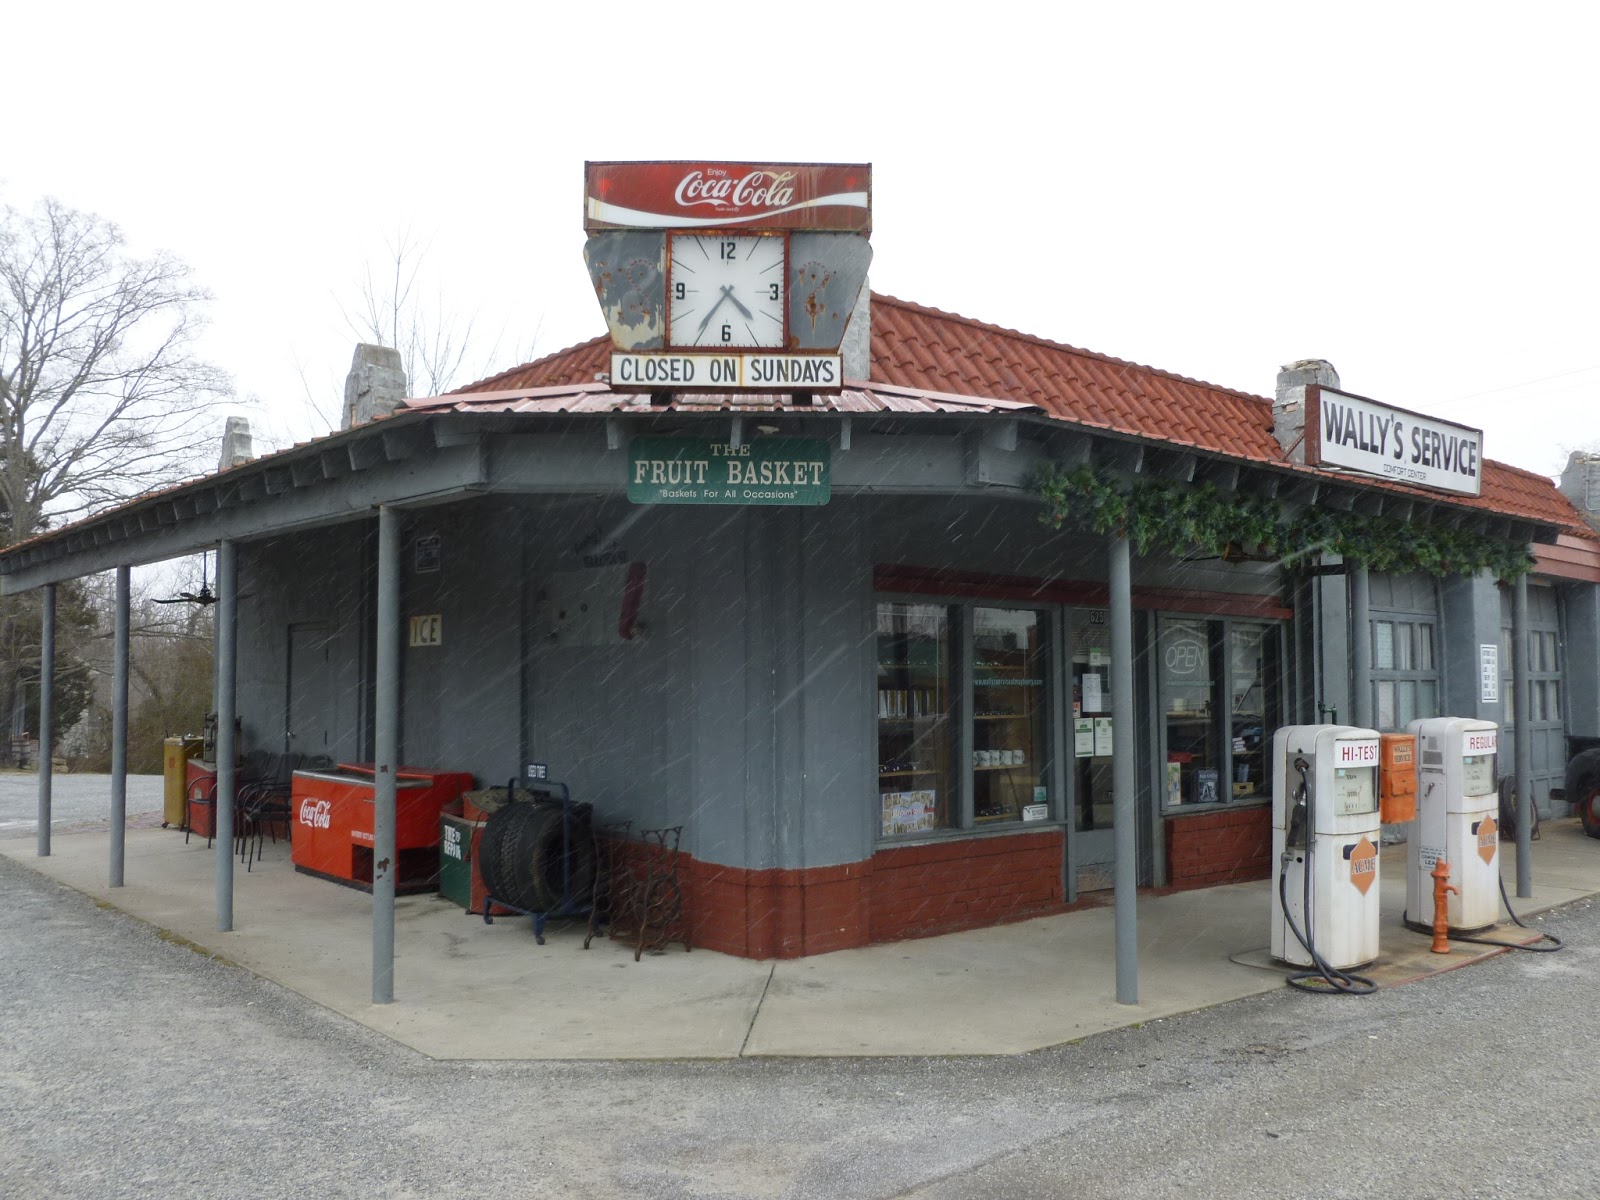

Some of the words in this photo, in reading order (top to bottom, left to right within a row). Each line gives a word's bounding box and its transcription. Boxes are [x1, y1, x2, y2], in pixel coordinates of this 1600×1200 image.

[707, 168, 727, 176] Enjoy
[674, 171, 798, 207] Coca-Cola
[720, 242, 736, 260] 12
[676, 282, 685, 300] 9
[769, 283, 779, 301] 3
[721, 325, 731, 342] 6
[620, 358, 695, 382] CLOSED
[709, 359, 737, 382] ON
[751, 359, 834, 383] SUNDAYS
[1323, 400, 1403, 460] WALLY'S
[1411, 426, 1477, 477] SERVICE
[710, 444, 751, 457] THE
[634, 460, 709, 484] FRUIT
[727, 460, 824, 485] BASKET
[1383, 463, 1407, 476] COMFORT
[1407, 469, 1427, 480] CENTER
[704, 489, 718, 498] For
[724, 489, 737, 498] All
[412, 617, 439, 644] ICE
[1165, 646, 1205, 668] OPEN
[1342, 745, 1378, 761] HI-TEST
[300, 798, 331, 829] Coca-Cola
[1352, 857, 1376, 874] ACME
